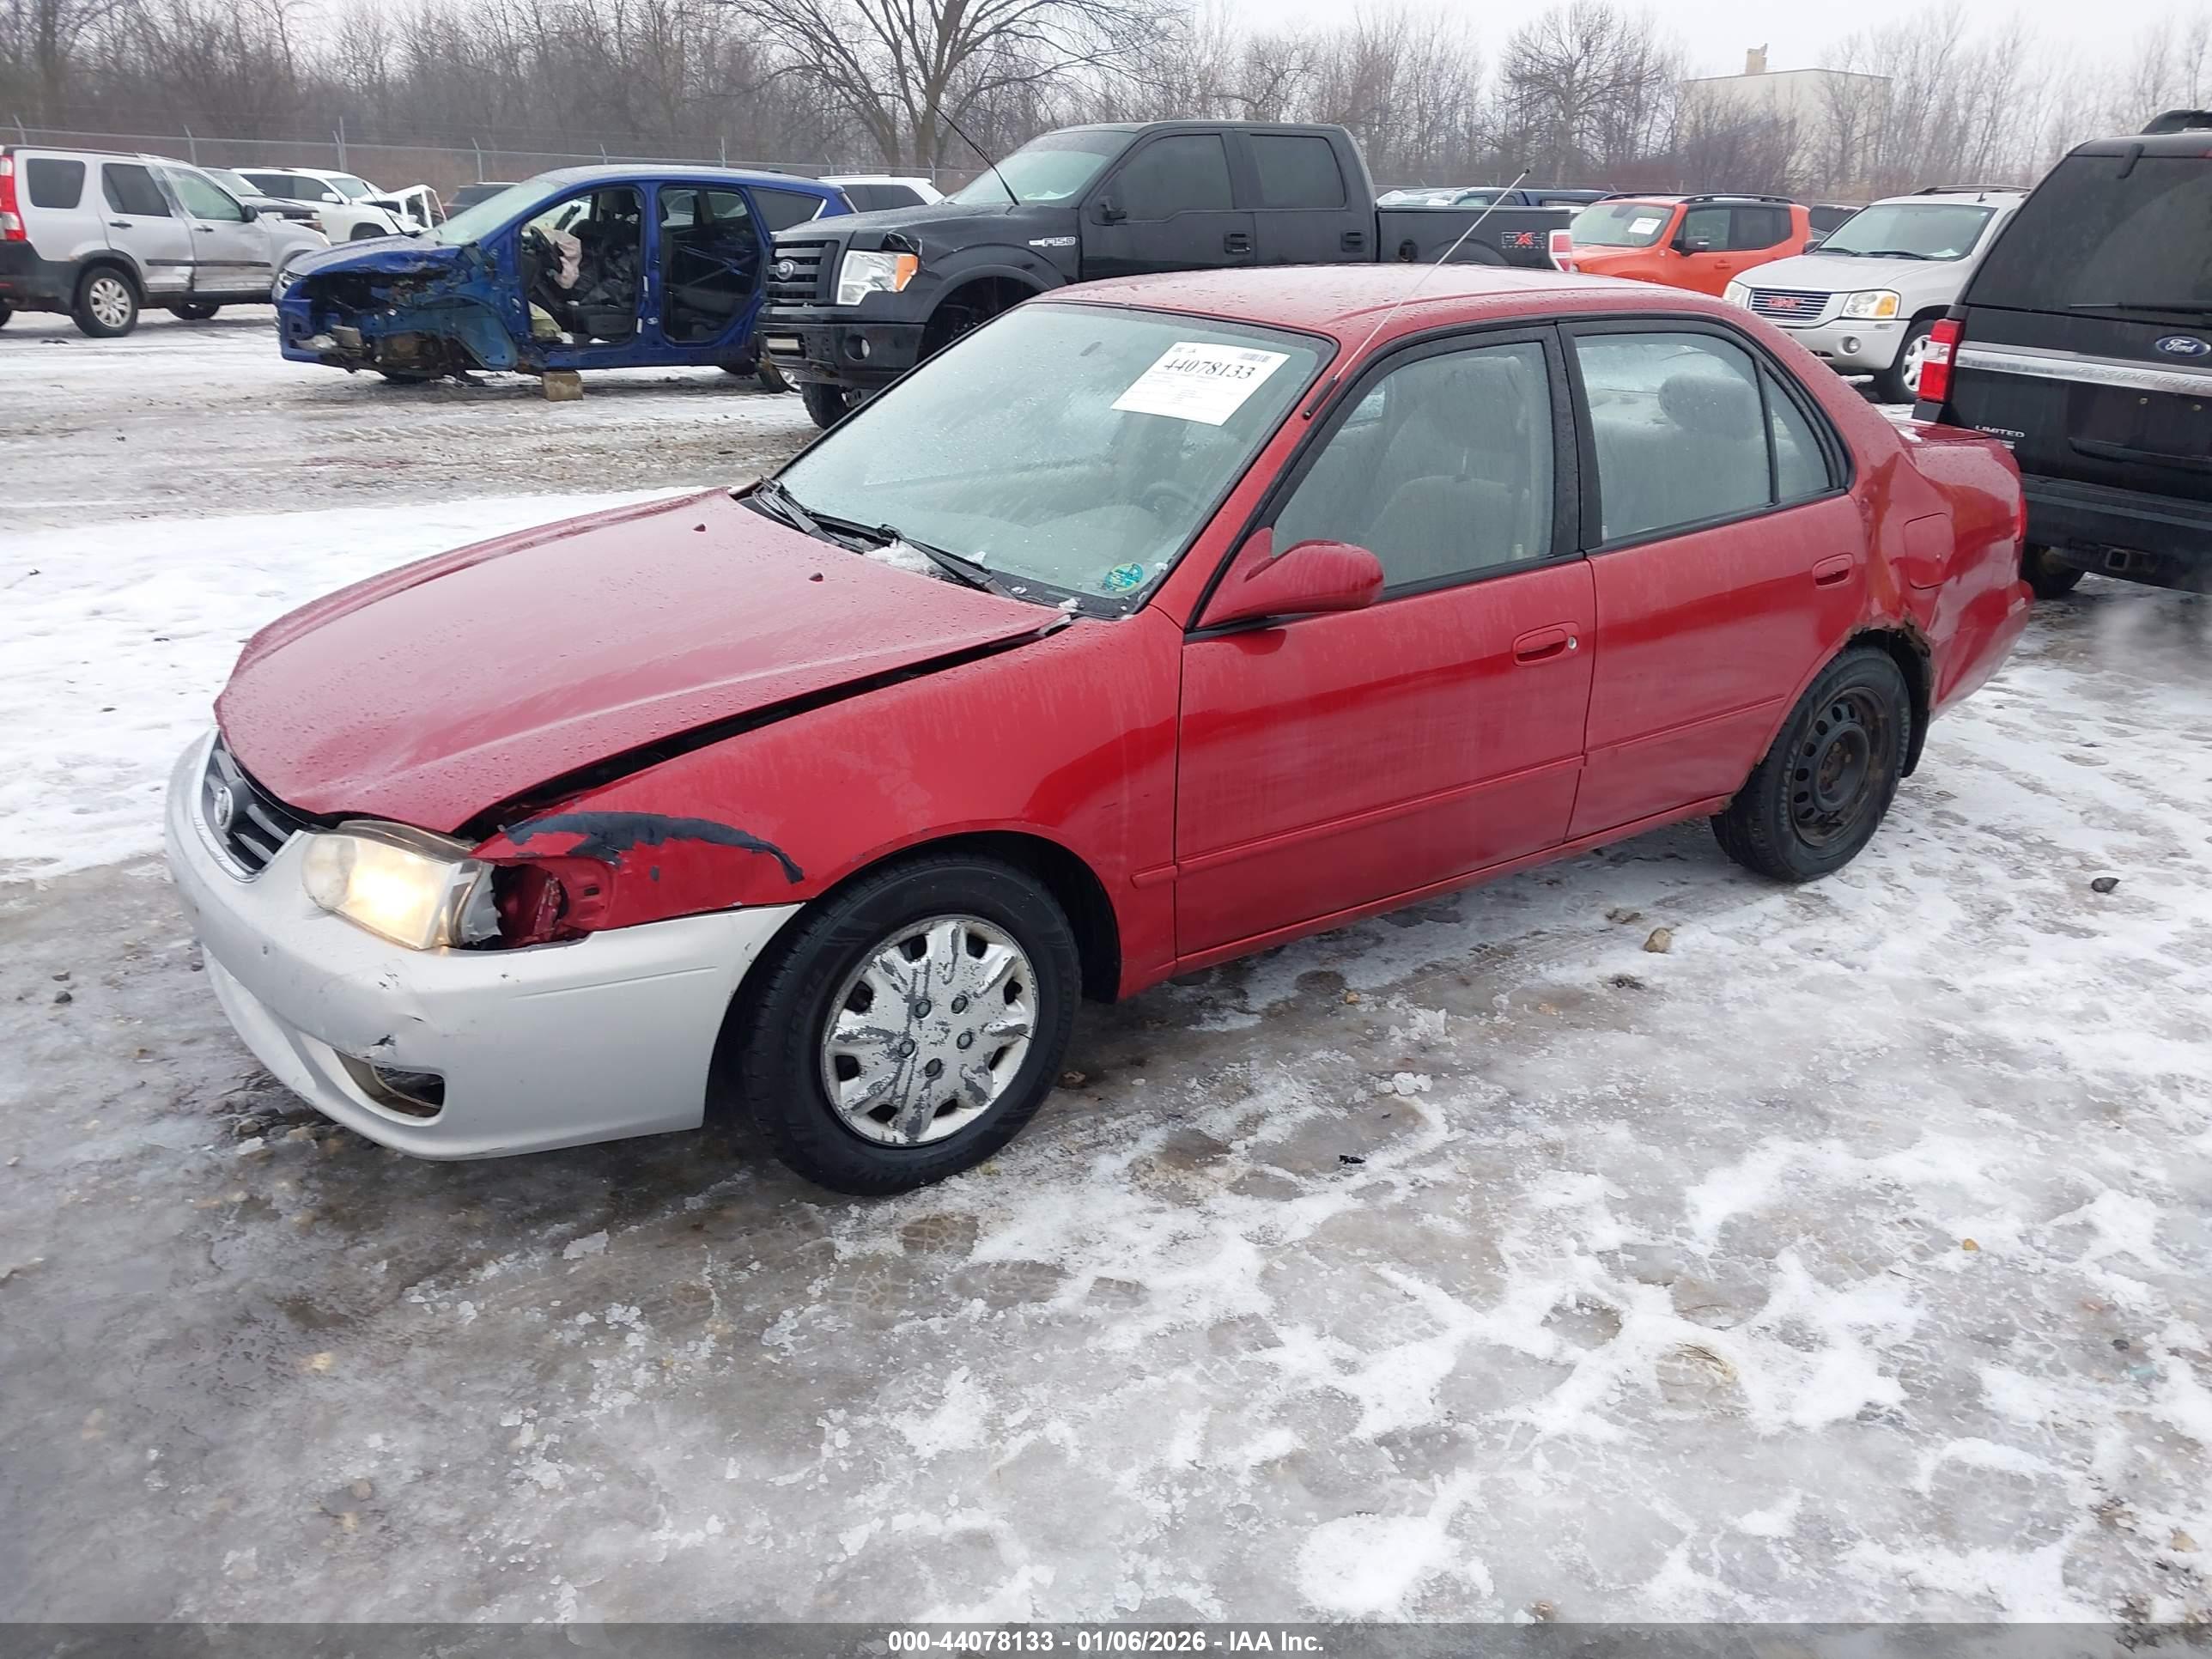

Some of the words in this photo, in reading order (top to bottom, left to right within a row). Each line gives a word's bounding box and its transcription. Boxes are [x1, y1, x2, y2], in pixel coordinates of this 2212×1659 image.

[1767, 296, 1802, 310] GMC
[2165, 338, 2198, 353] Ford
[1164, 358, 1256, 380] 44078133
[1975, 425, 2025, 438] LIMITED
